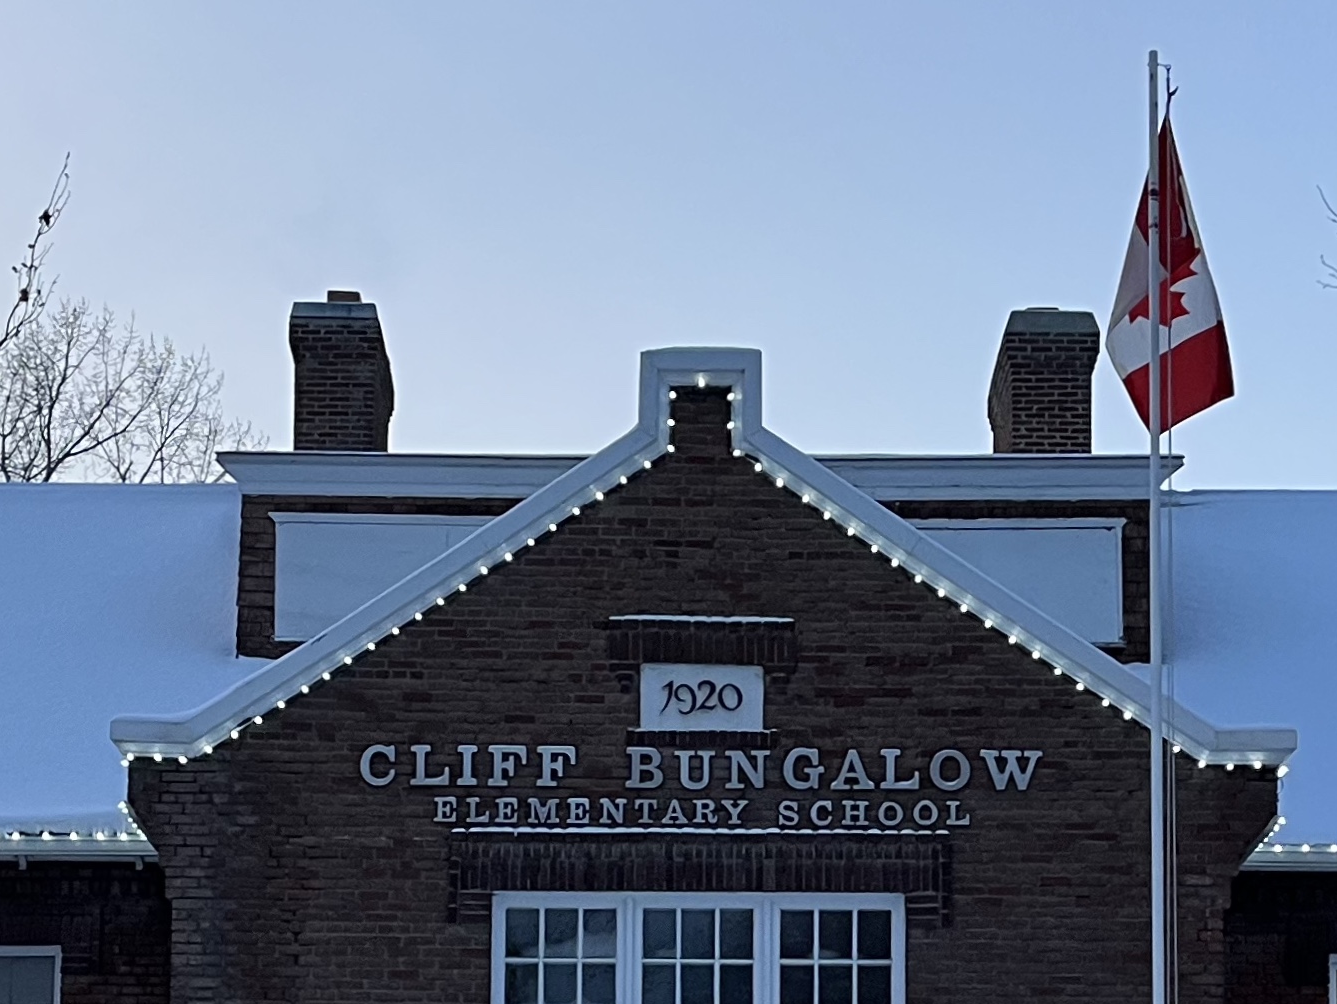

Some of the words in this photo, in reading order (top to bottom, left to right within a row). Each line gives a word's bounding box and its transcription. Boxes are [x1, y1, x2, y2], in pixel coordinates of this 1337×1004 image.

[659, 680, 743, 716] 1920
[359, 744, 577, 787] CLIFF
[624, 746, 1043, 791] BUNGALOW
[433, 796, 749, 825] ELEMENTARY
[778, 799, 970, 826] SCHOOL
